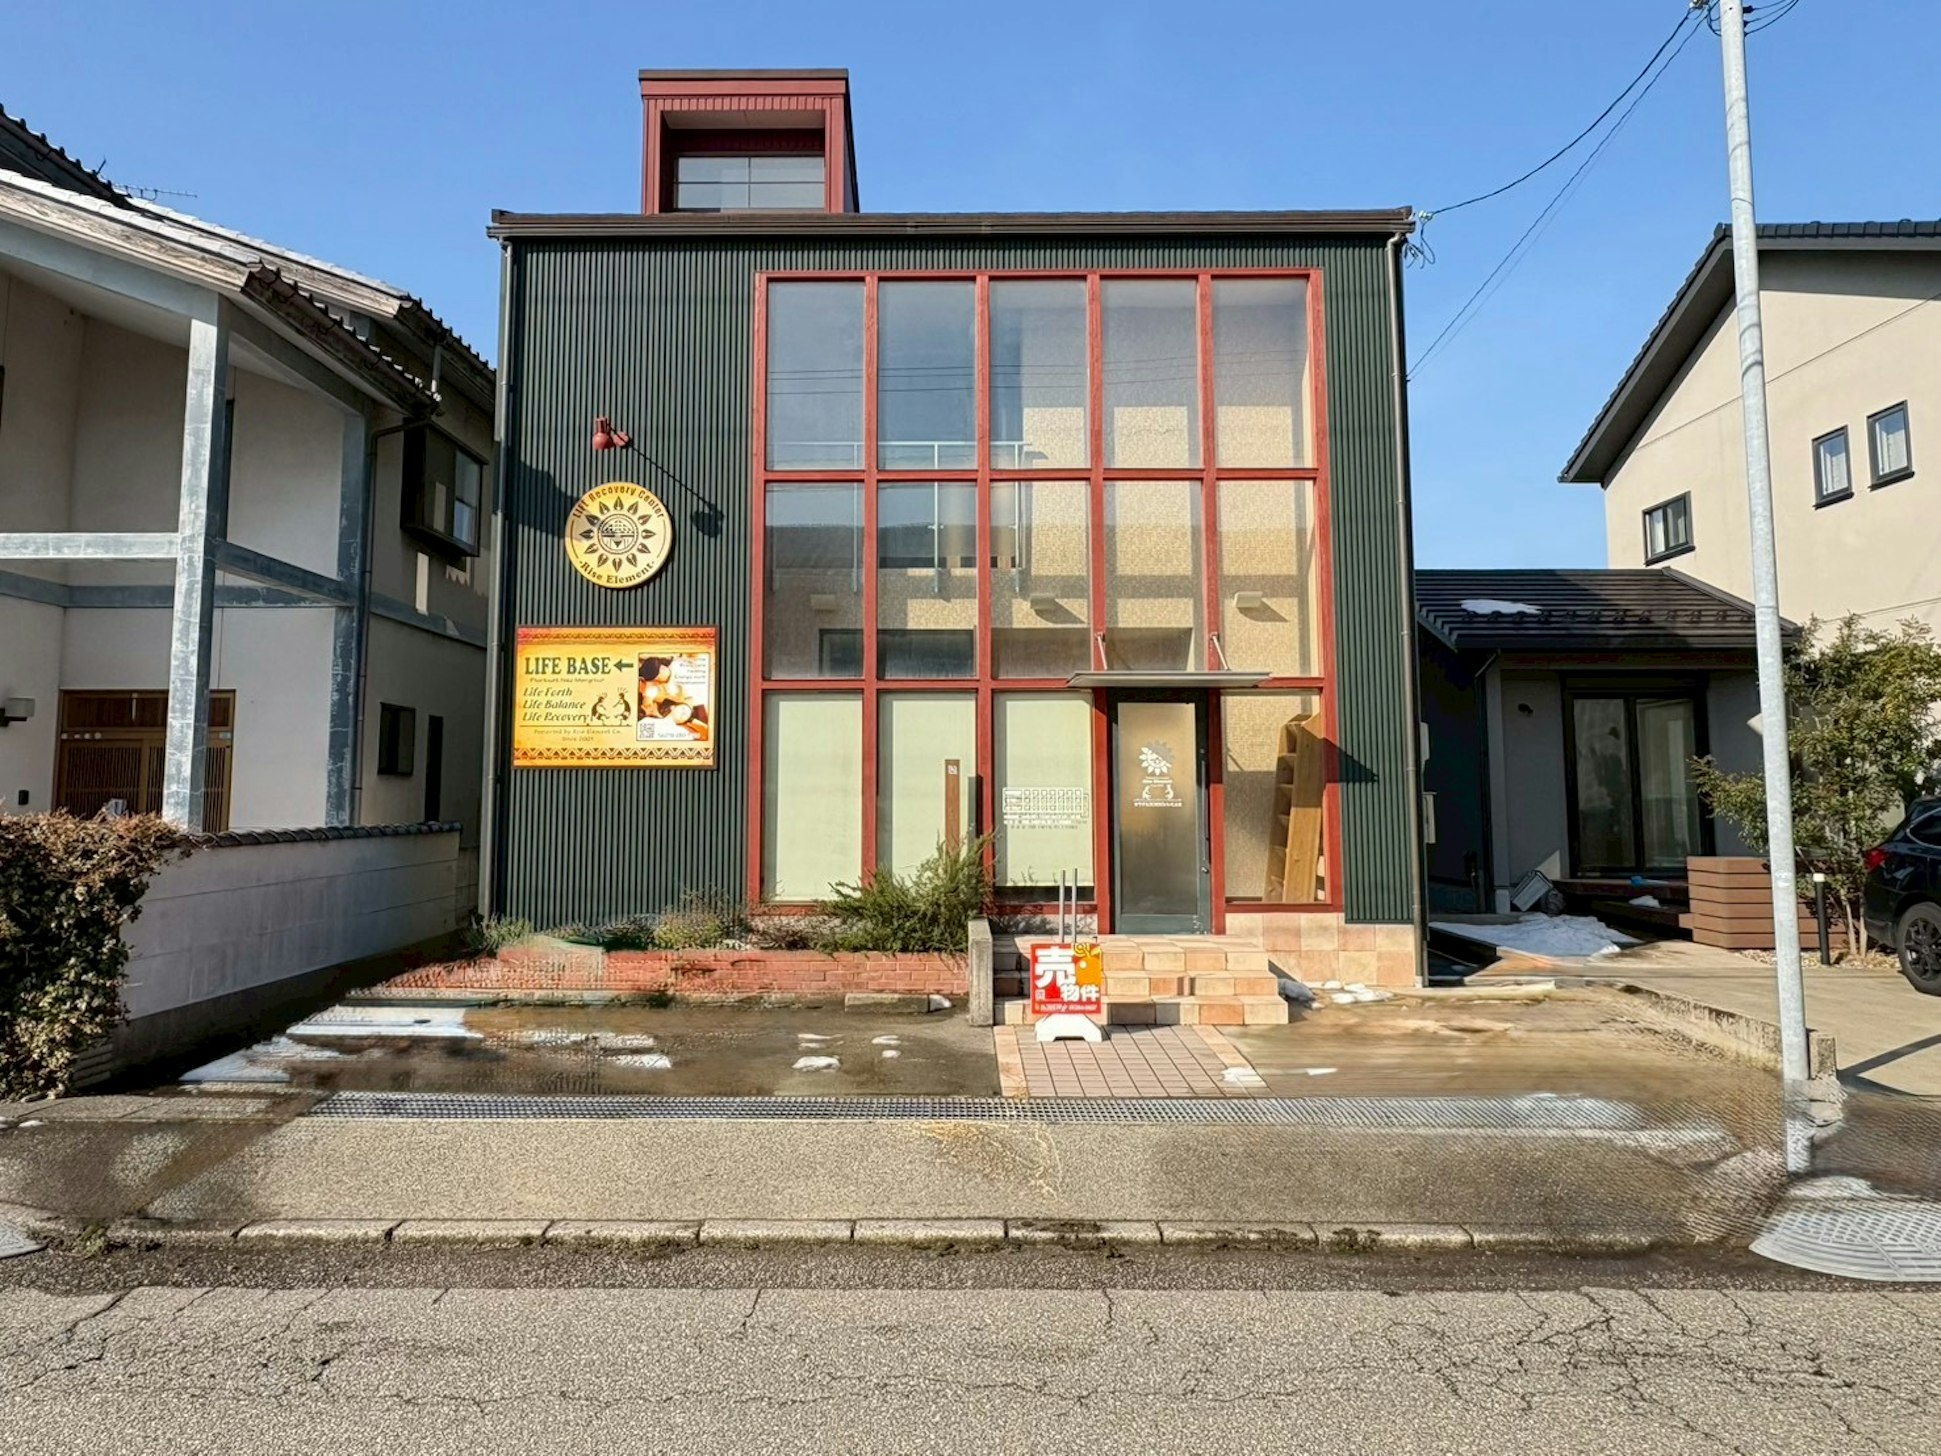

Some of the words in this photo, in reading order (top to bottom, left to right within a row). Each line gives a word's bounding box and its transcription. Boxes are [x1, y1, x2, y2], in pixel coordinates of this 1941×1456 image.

[525, 657, 562, 675] LIFE
[566, 657, 612, 675] BASE
[523, 687, 544, 697] Life
[522, 699, 543, 709] Life
[544, 699, 586, 709] Balance
[522, 711, 543, 721] Life
[544, 711, 589, 723] Recovery
[1034, 946, 1076, 988] 売
[1060, 984, 1099, 1002] 物件
